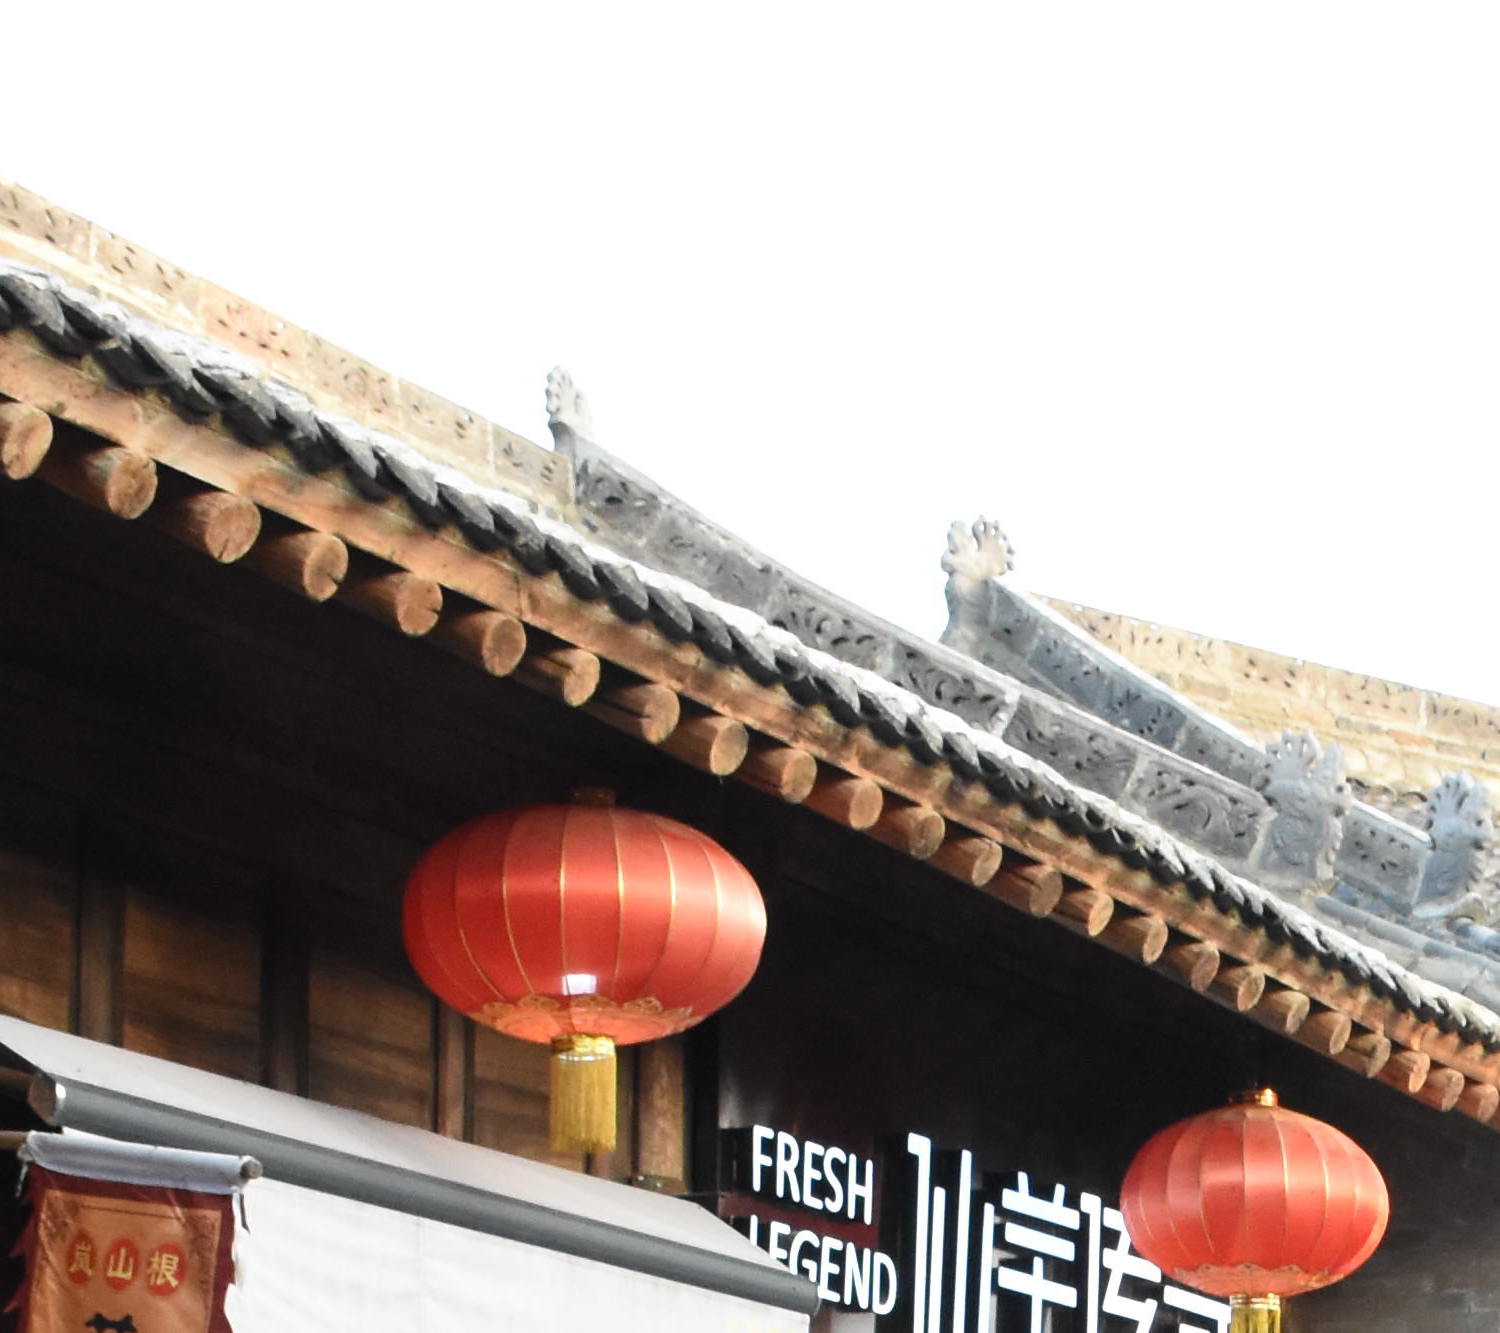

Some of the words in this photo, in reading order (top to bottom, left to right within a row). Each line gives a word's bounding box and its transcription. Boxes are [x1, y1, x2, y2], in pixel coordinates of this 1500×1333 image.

[752, 1124, 874, 1226] FRESH
[69, 1236, 181, 1290] 岚山根
